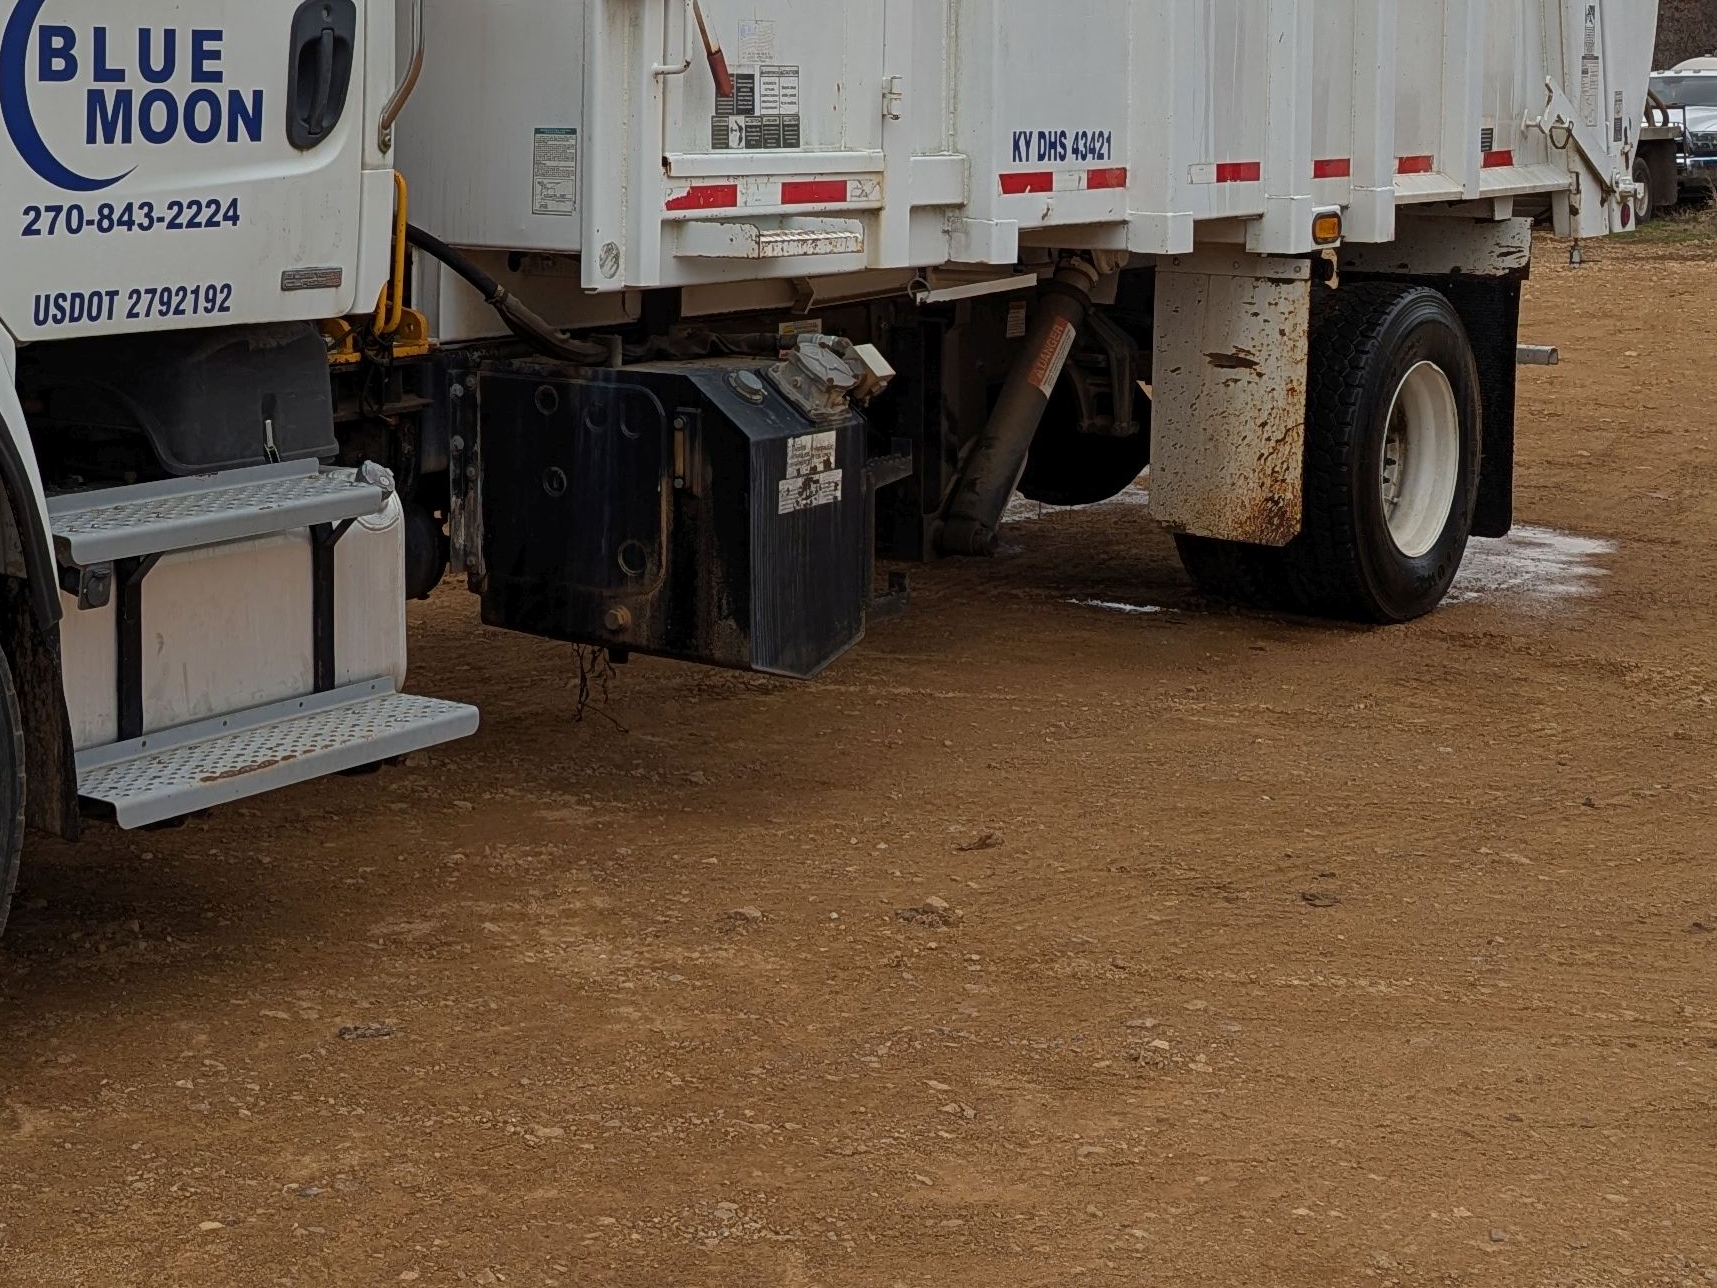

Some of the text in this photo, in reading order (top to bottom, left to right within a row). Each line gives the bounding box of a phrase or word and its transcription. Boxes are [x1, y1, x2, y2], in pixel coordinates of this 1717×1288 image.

[38, 24, 224, 84] BLUE
[85, 88, 264, 145] MOON
[1012, 129, 1112, 163] KY DHS 43421
[20, 197, 241, 237] 270-843-2224
[33, 282, 233, 327] USDOT 2792192
[1038, 324, 1064, 370] DANGER
